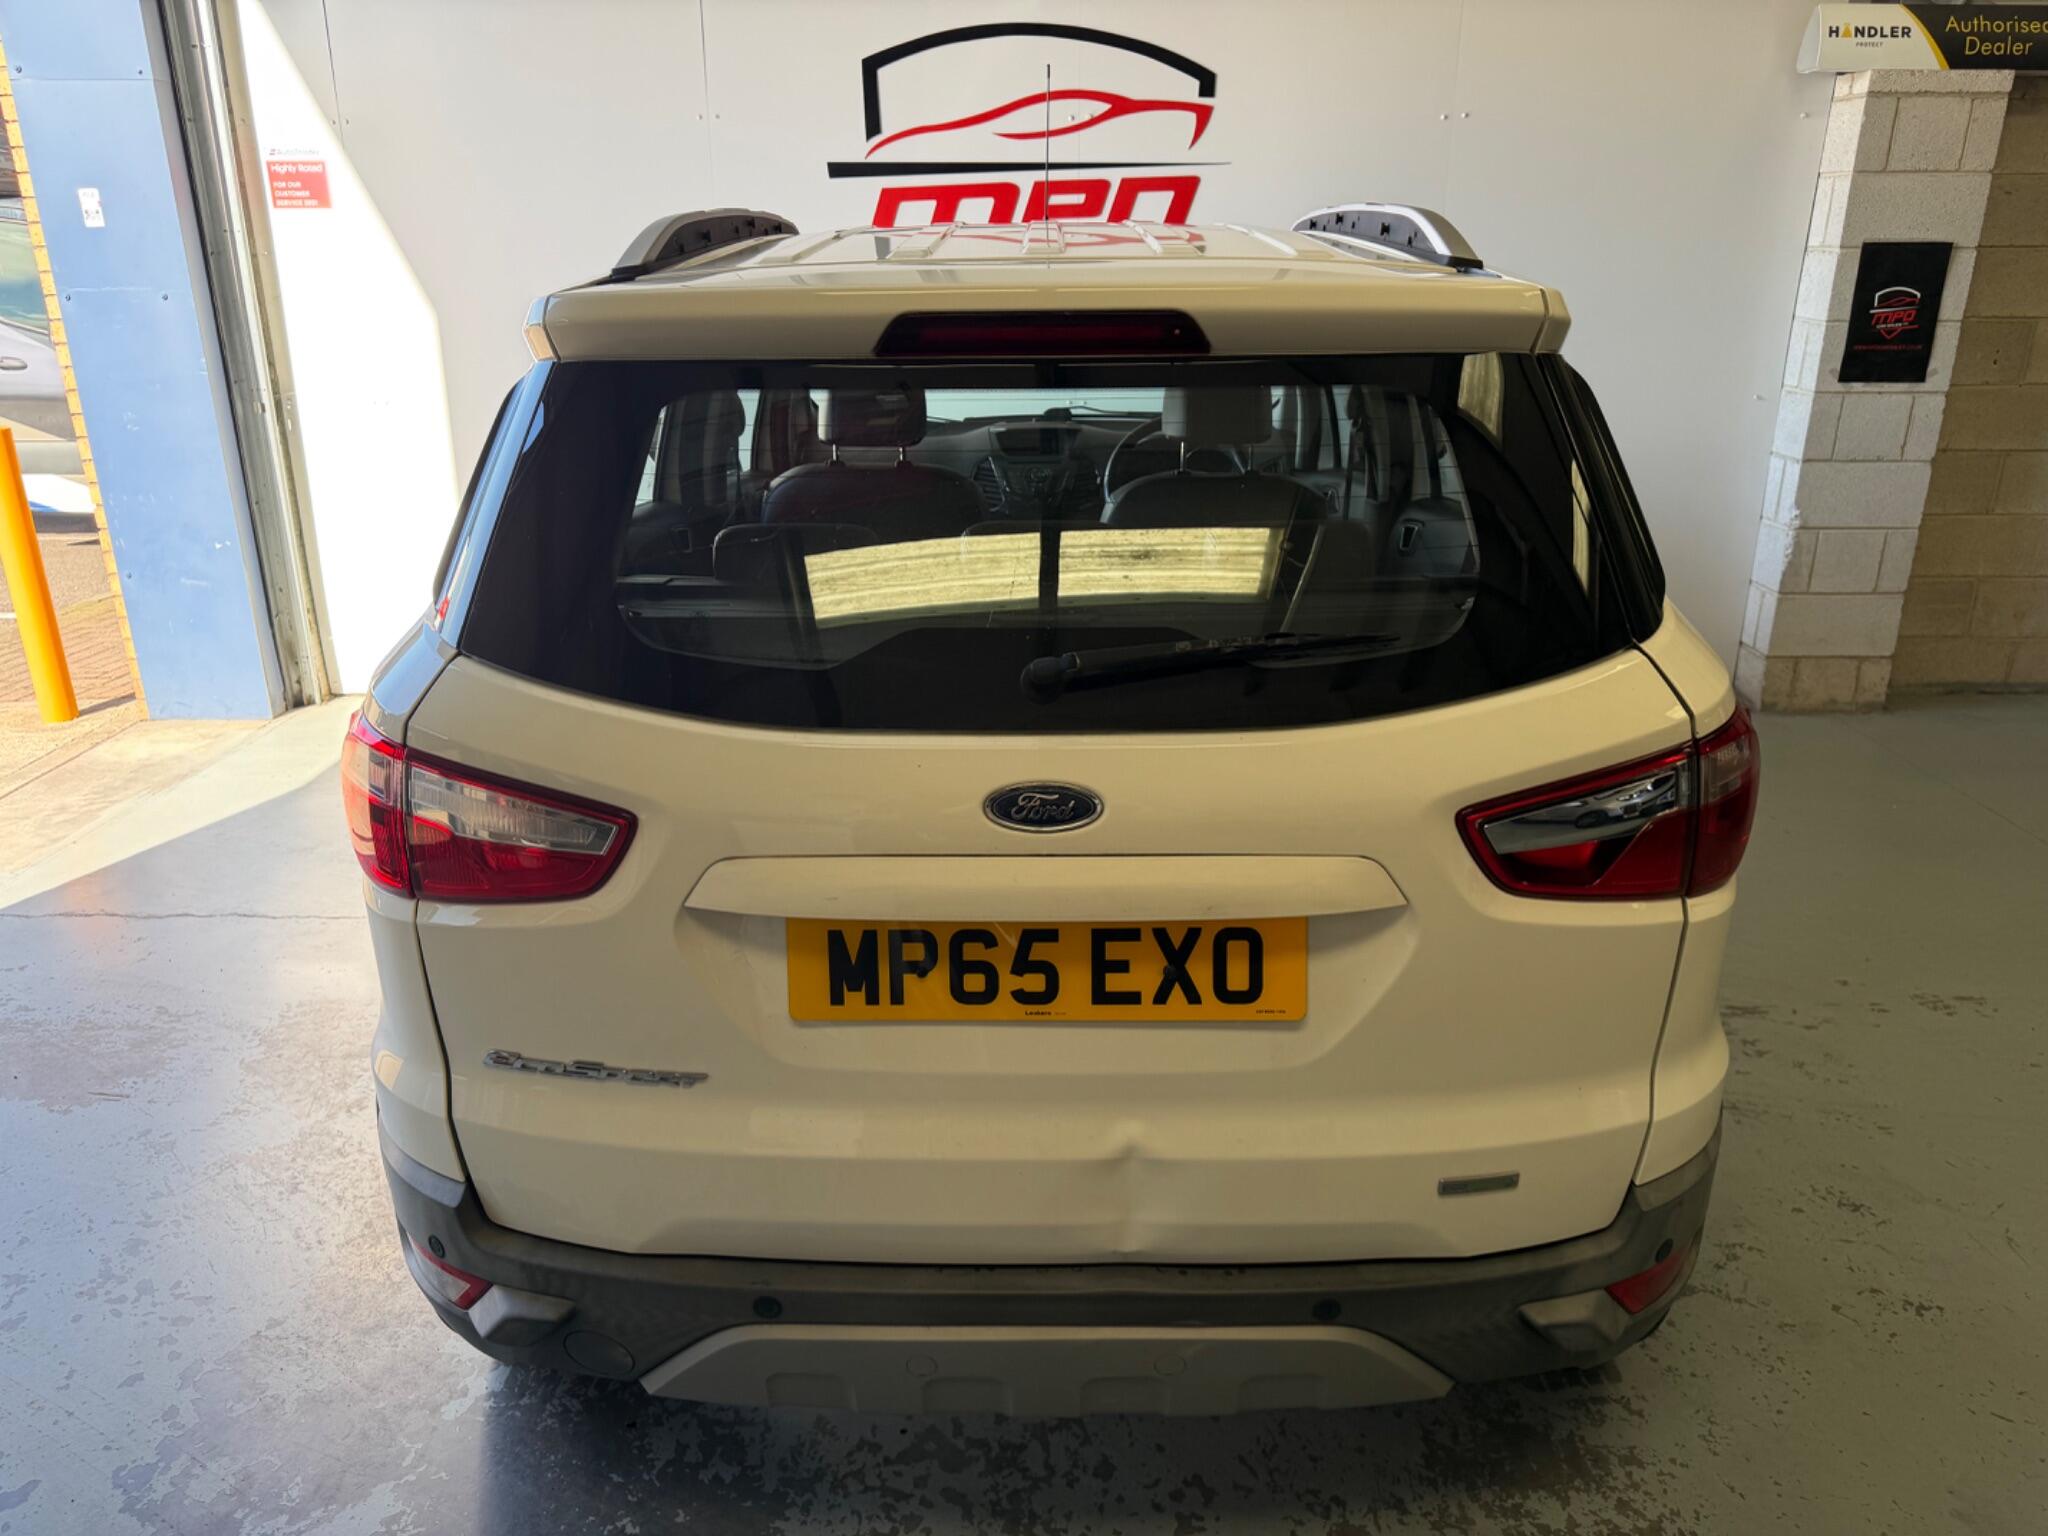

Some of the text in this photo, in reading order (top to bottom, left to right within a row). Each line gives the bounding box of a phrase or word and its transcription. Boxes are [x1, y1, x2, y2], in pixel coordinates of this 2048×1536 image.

[1965, 36, 2033, 56] Dealer
[1010, 792, 1076, 820] Ford
[826, 926, 1265, 1007] MP65 EXO
